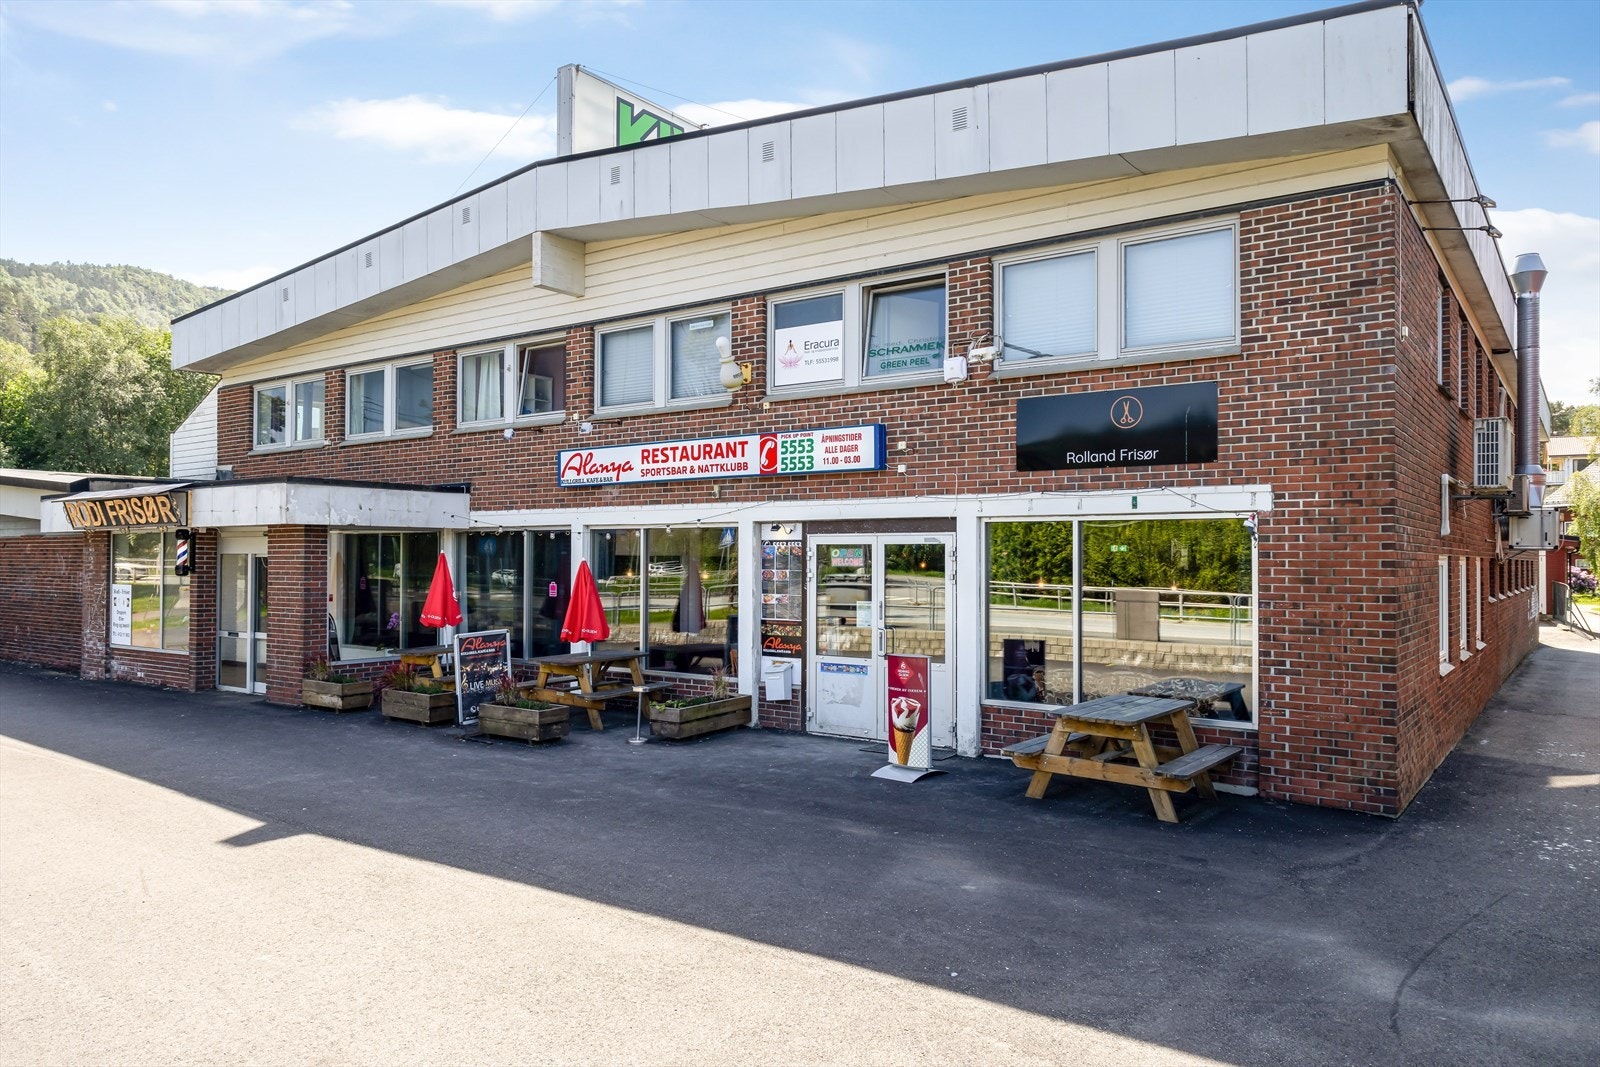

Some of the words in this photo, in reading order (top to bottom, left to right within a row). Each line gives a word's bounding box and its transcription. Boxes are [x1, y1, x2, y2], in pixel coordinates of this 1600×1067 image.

[804, 338, 839, 350] Eracura
[868, 341, 945, 357] SCHRAMMEK
[880, 359, 907, 370] GREEN
[909, 357, 930, 366] PEEL
[821, 433, 863, 443] ÅPNINGSTIDER
[640, 440, 749, 464] RESTAURANT
[781, 438, 814, 455] 5553
[824, 446, 838, 454] ALLE
[839, 444, 859, 453] DAGER
[781, 455, 814, 471] 5553
[822, 456, 839, 465] 11.00
[844, 455, 861, 464] 03.00
[1066, 449, 1116, 464] Rolland
[1120, 448, 1159, 461] Frisør
[561, 452, 634, 481] Alanya
[640, 464, 689, 478] SPORTSBAR
[689, 465, 696, 474] &
[697, 461, 749, 474] NATTKLUBB
[65, 500, 107, 528] RODI
[106, 495, 177, 527] FRISØR
[831, 548, 863, 557] OPEN
[832, 558, 864, 566] WELCOME
[461, 636, 507, 651] Alanya
[763, 636, 802, 654] Alanya
[469, 680, 485, 690] LIVE
